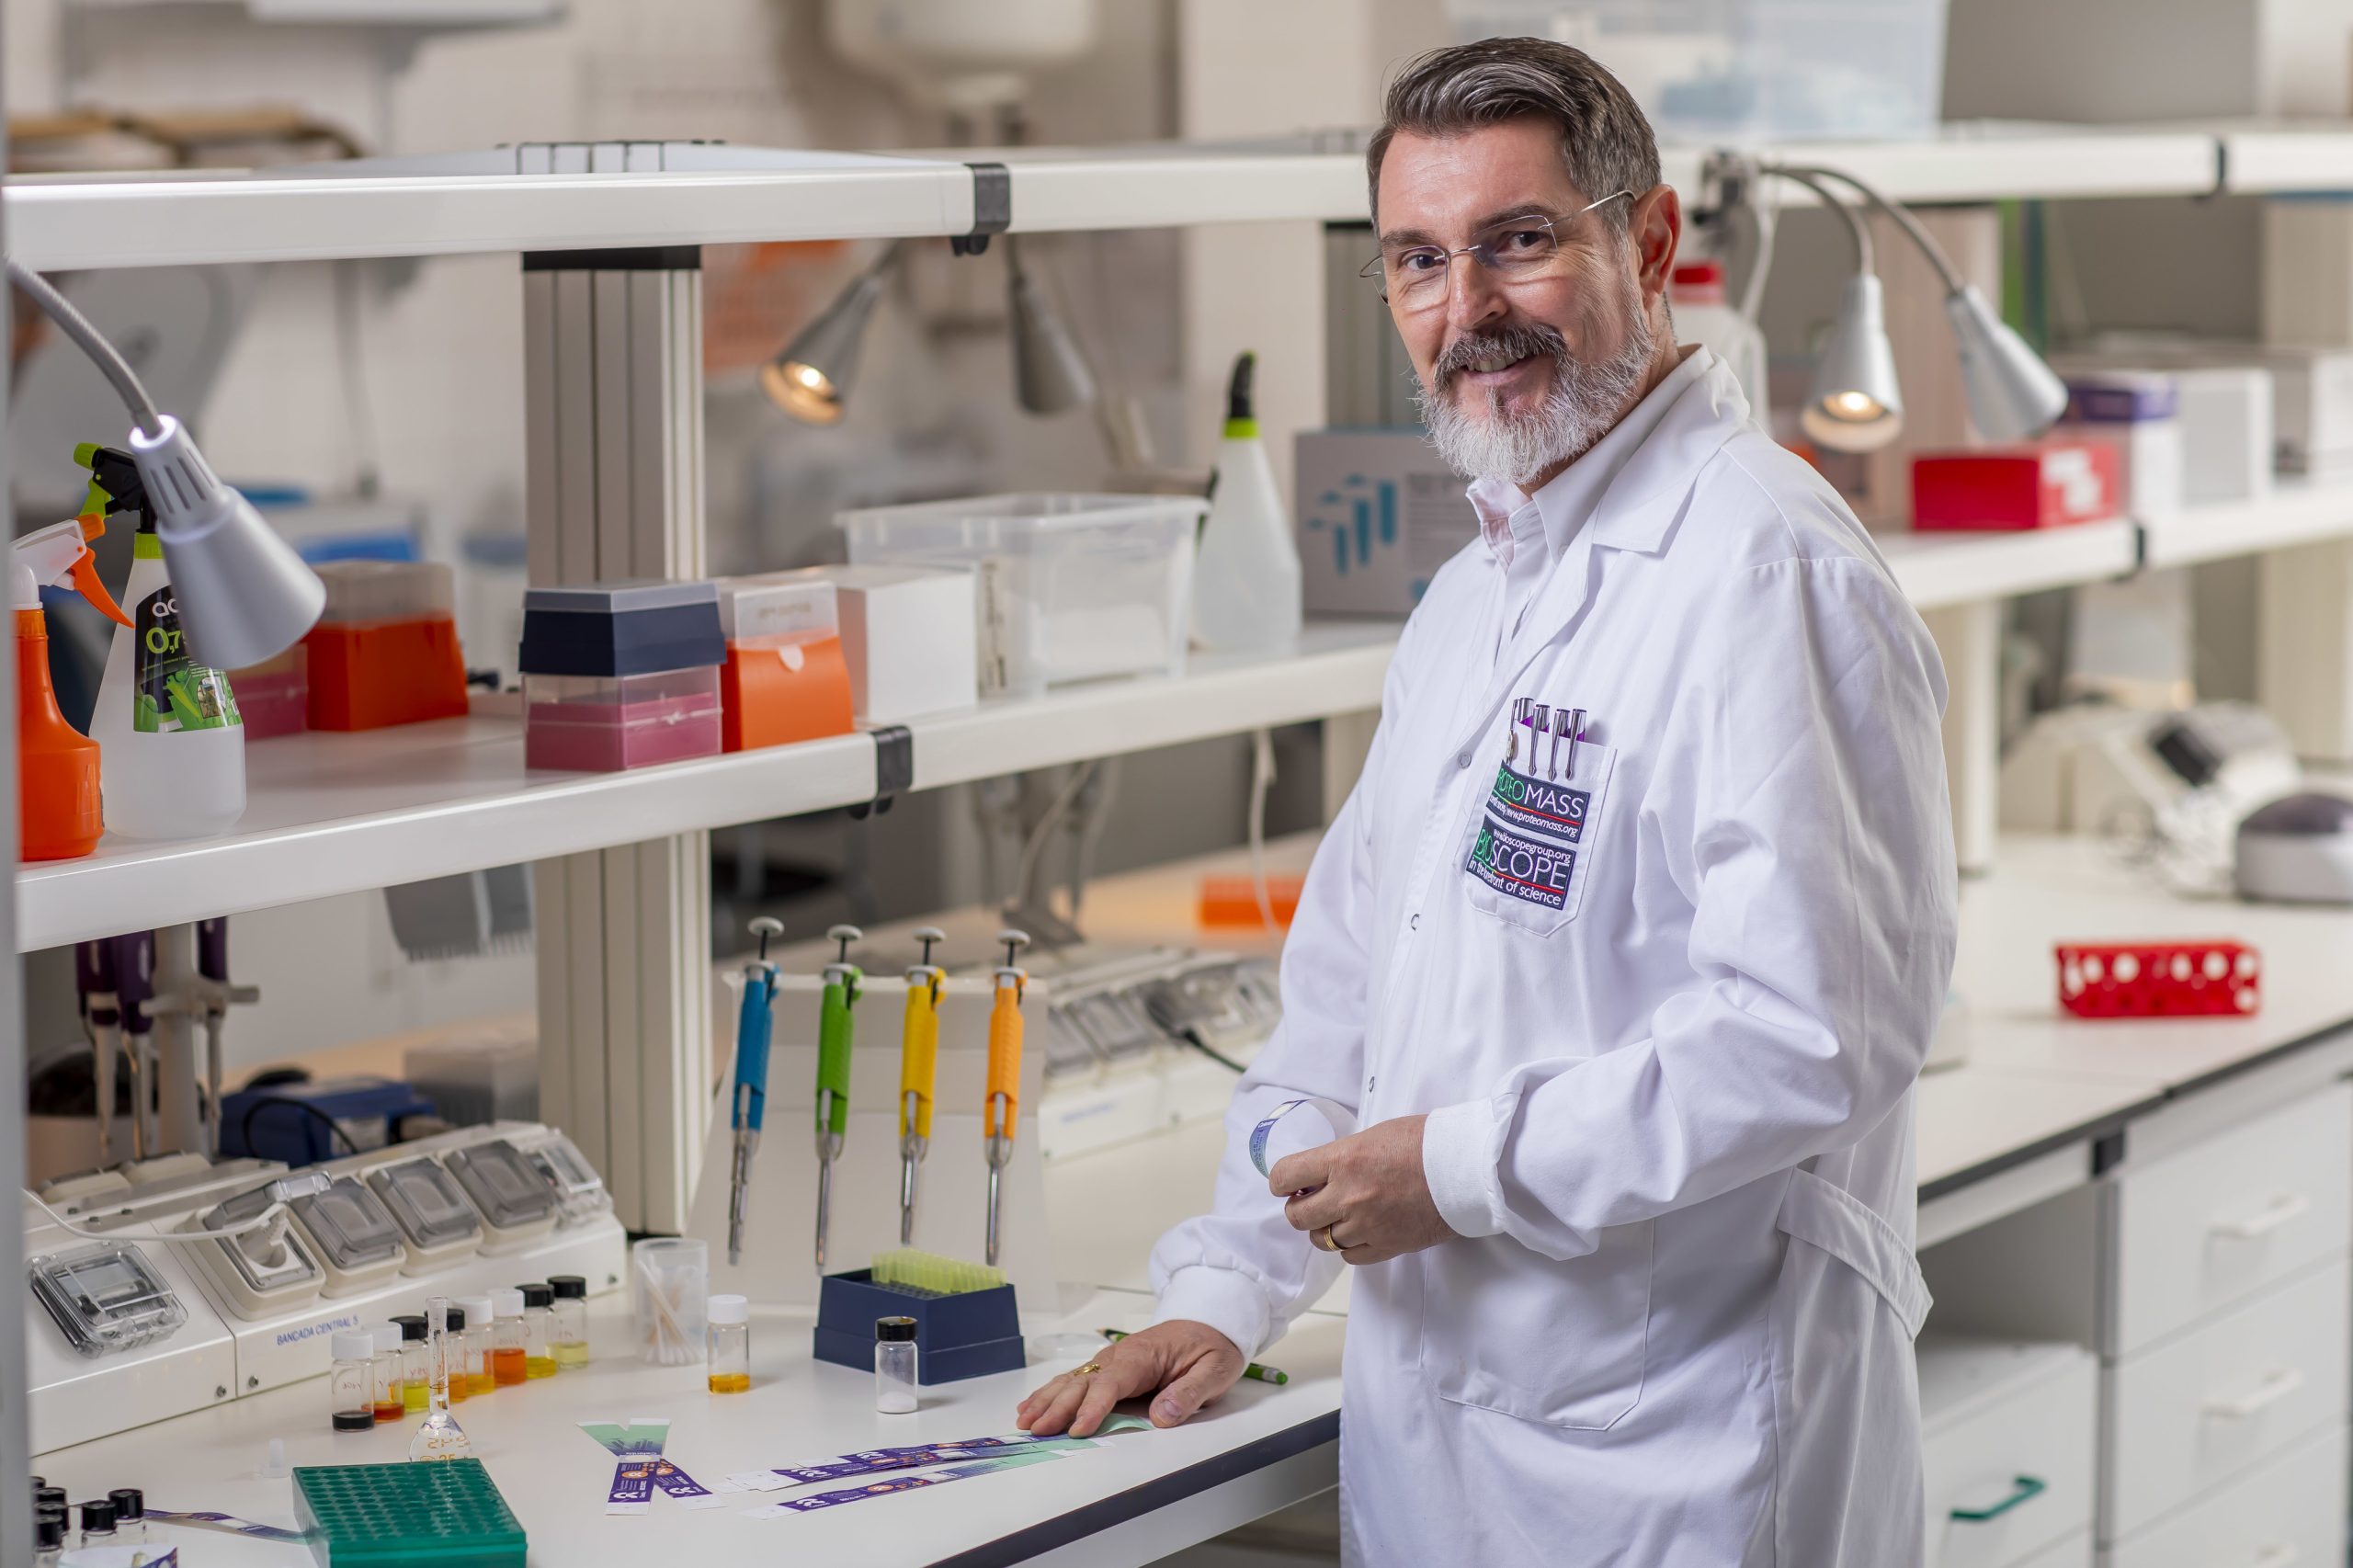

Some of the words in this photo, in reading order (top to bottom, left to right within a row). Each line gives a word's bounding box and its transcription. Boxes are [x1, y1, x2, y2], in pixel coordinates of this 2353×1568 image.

[146, 626, 187, 654] 0,7
[1496, 767, 1585, 819] PROTEOMASS
[1468, 856, 1477, 870] in
[1506, 881, 1520, 893] of
[1518, 886, 1562, 905] science
[1475, 828, 1570, 890] BIOSCOPE
[315, 1317, 351, 1335] CENTRAL
